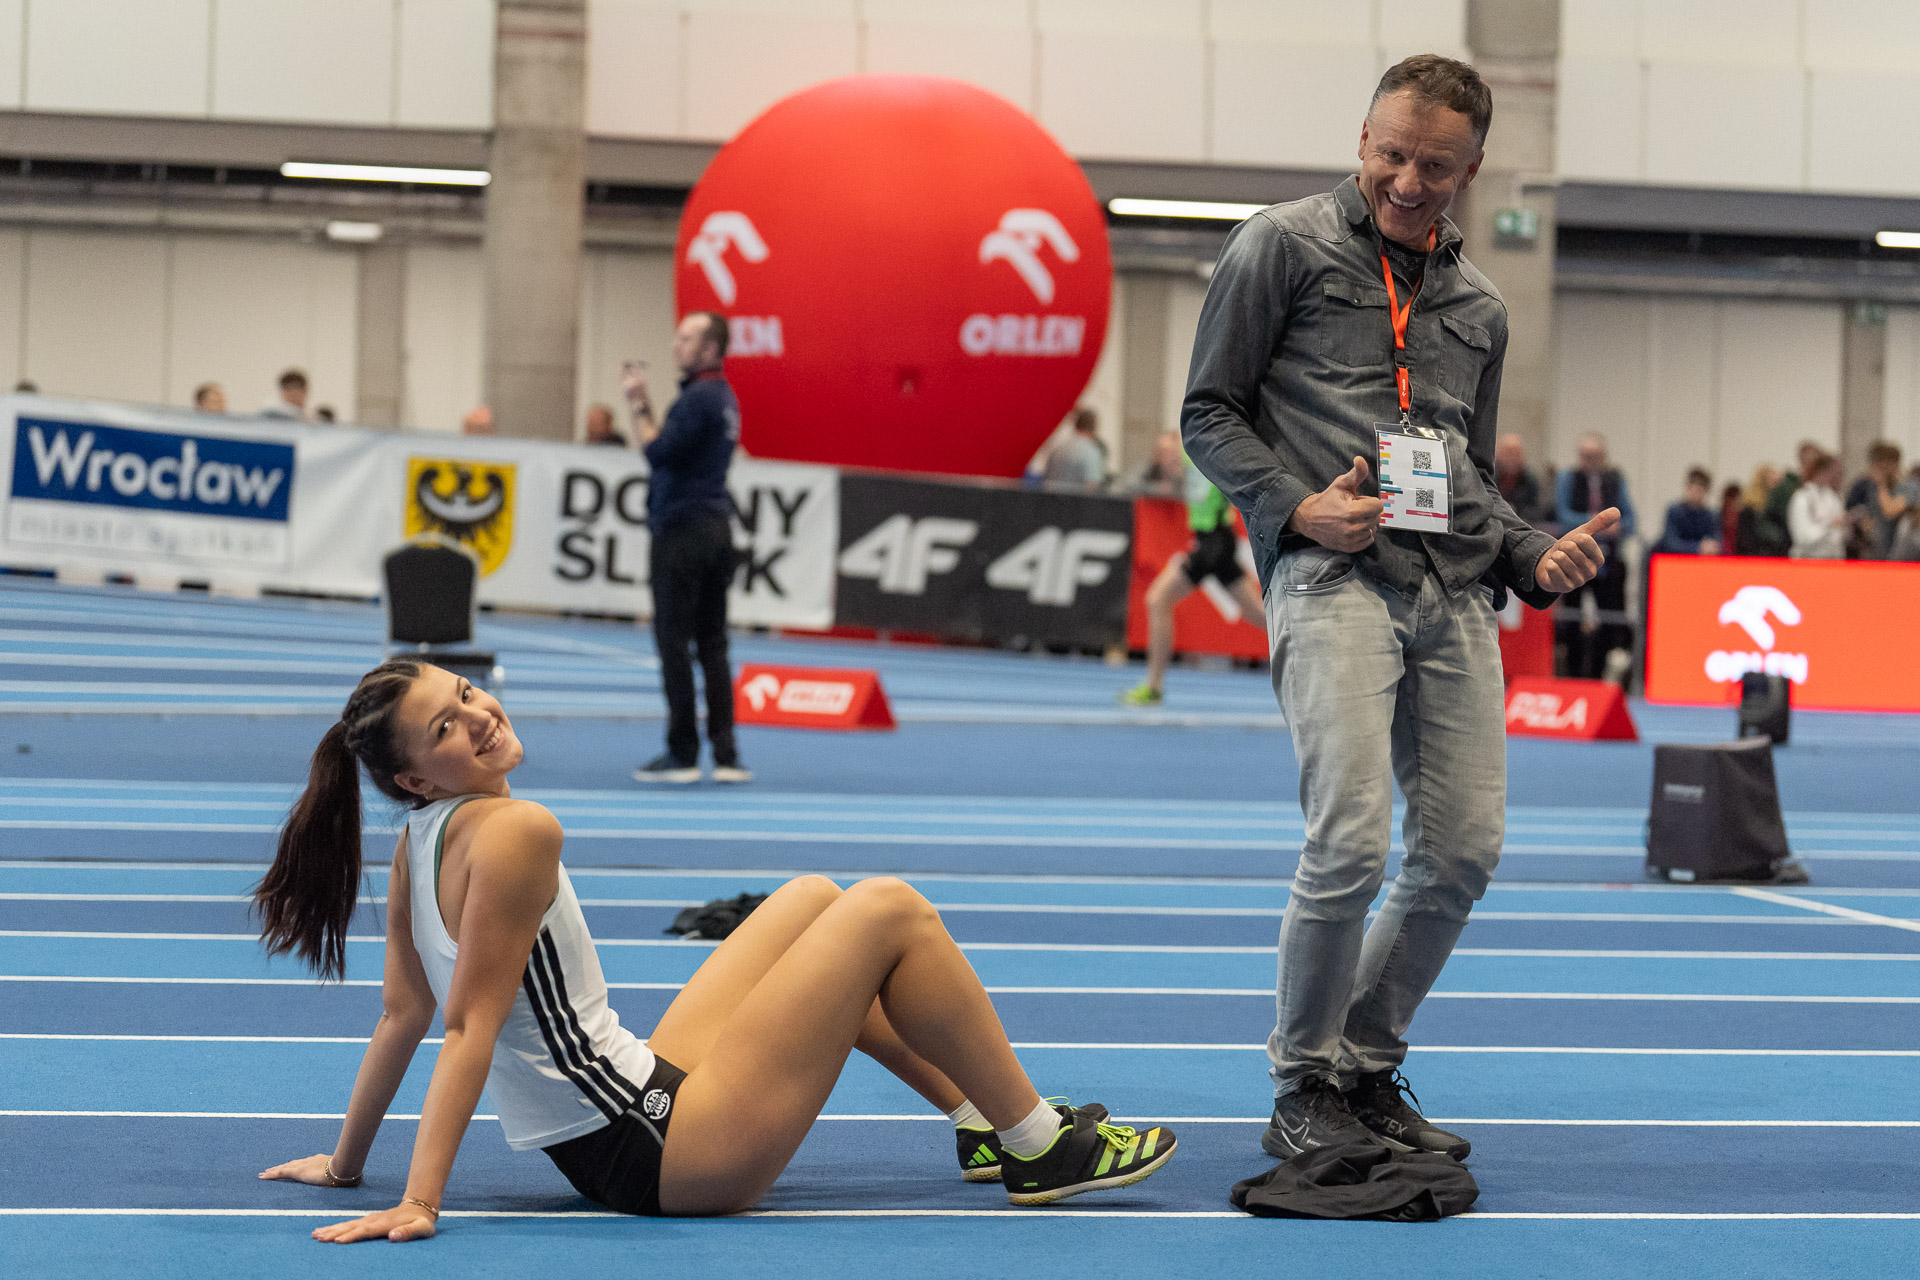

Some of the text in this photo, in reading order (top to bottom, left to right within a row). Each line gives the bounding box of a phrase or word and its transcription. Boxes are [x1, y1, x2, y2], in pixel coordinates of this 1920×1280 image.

[960, 314, 1085, 356] ORLEN
[28, 426, 284, 508] Wrocław
[563, 472, 809, 535] DONY
[838, 513, 978, 595] 4F
[985, 526, 1129, 606] 4F
